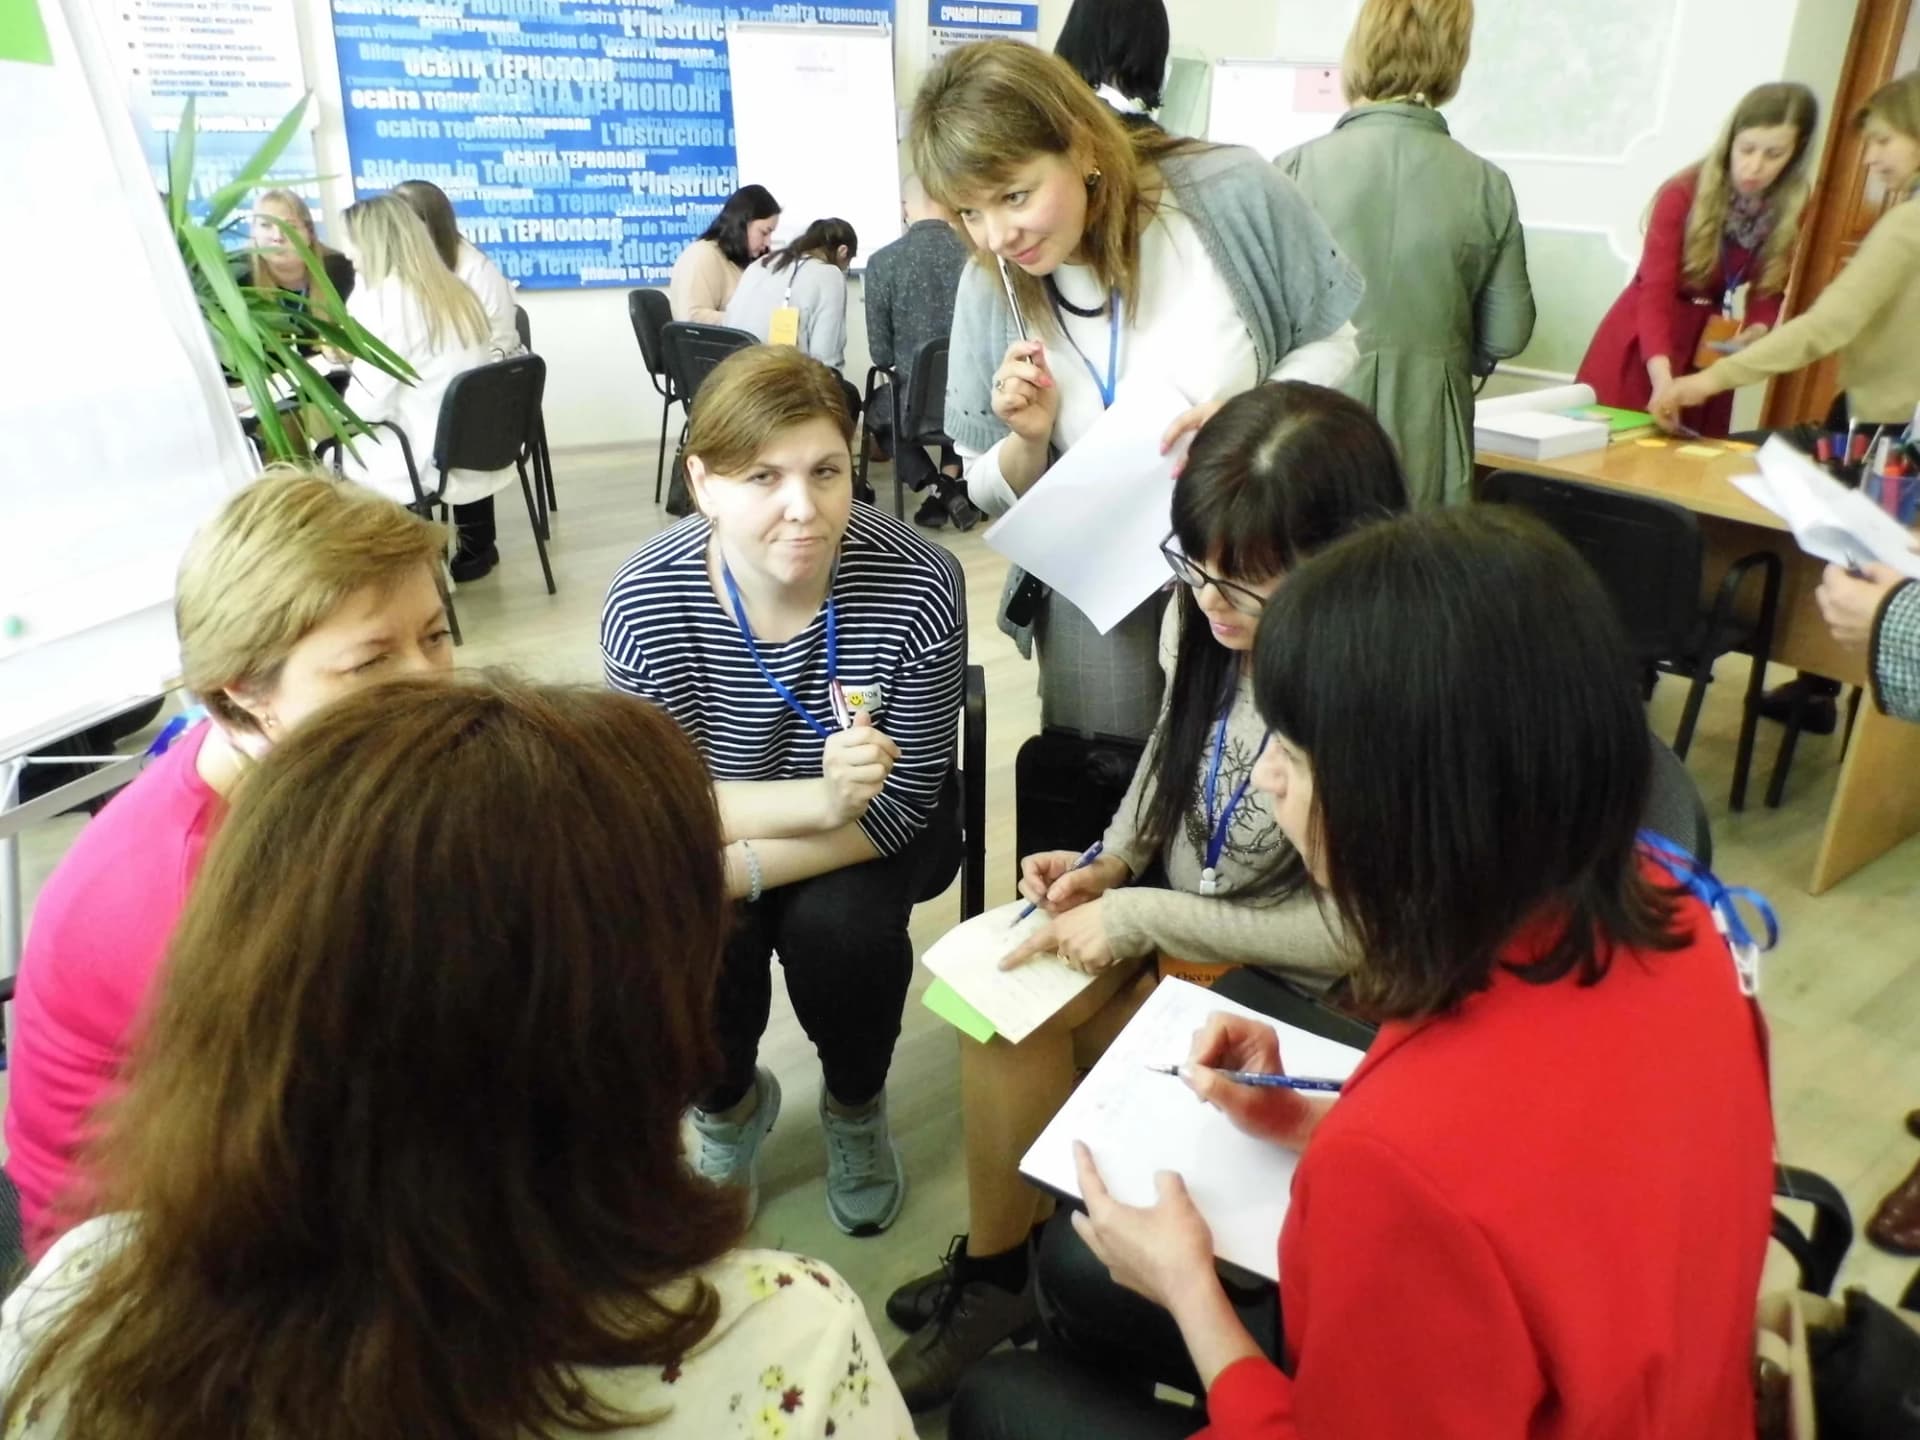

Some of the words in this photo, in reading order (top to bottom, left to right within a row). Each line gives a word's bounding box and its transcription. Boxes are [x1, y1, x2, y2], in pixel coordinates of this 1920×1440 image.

[350, 87, 421, 110] освіта
[578, 80, 721, 114] ТЕРНОПОЛЯ
[376, 118, 440, 139] освіта
[560, 150, 646, 169] ТЕРНОПОЛЯ
[504, 218, 624, 243] ТЕРНОПОЛЯ
[609, 236, 697, 267] Educa
